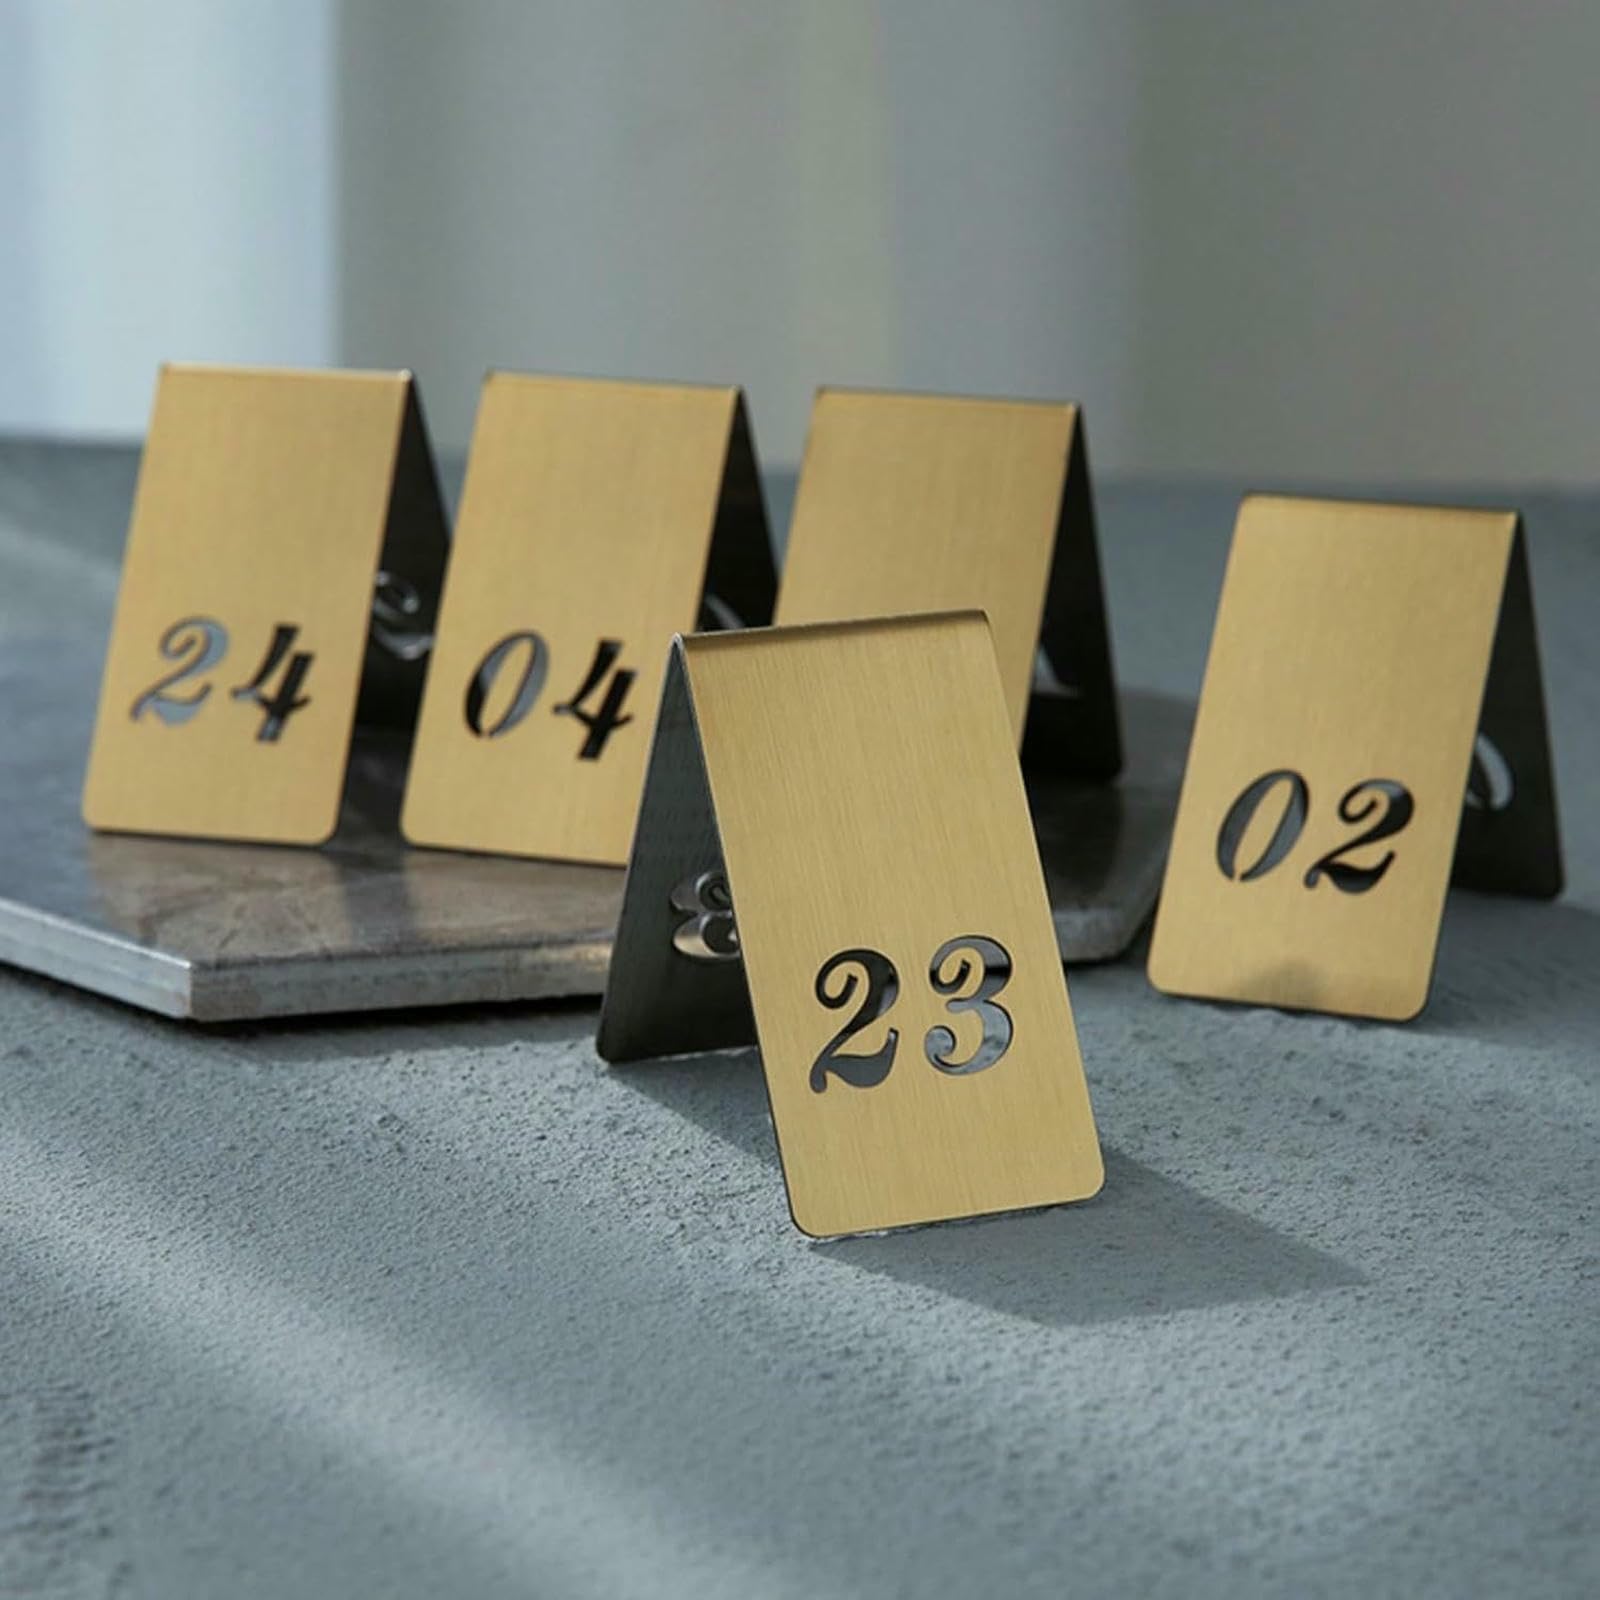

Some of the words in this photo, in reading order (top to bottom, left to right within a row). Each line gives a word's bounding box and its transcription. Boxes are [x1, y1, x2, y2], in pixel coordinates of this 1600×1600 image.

[129, 614, 315, 744] 24
[464, 629, 637, 760] 04
[1215, 769, 1414, 894] 02
[809, 934, 1014, 1094] 23
